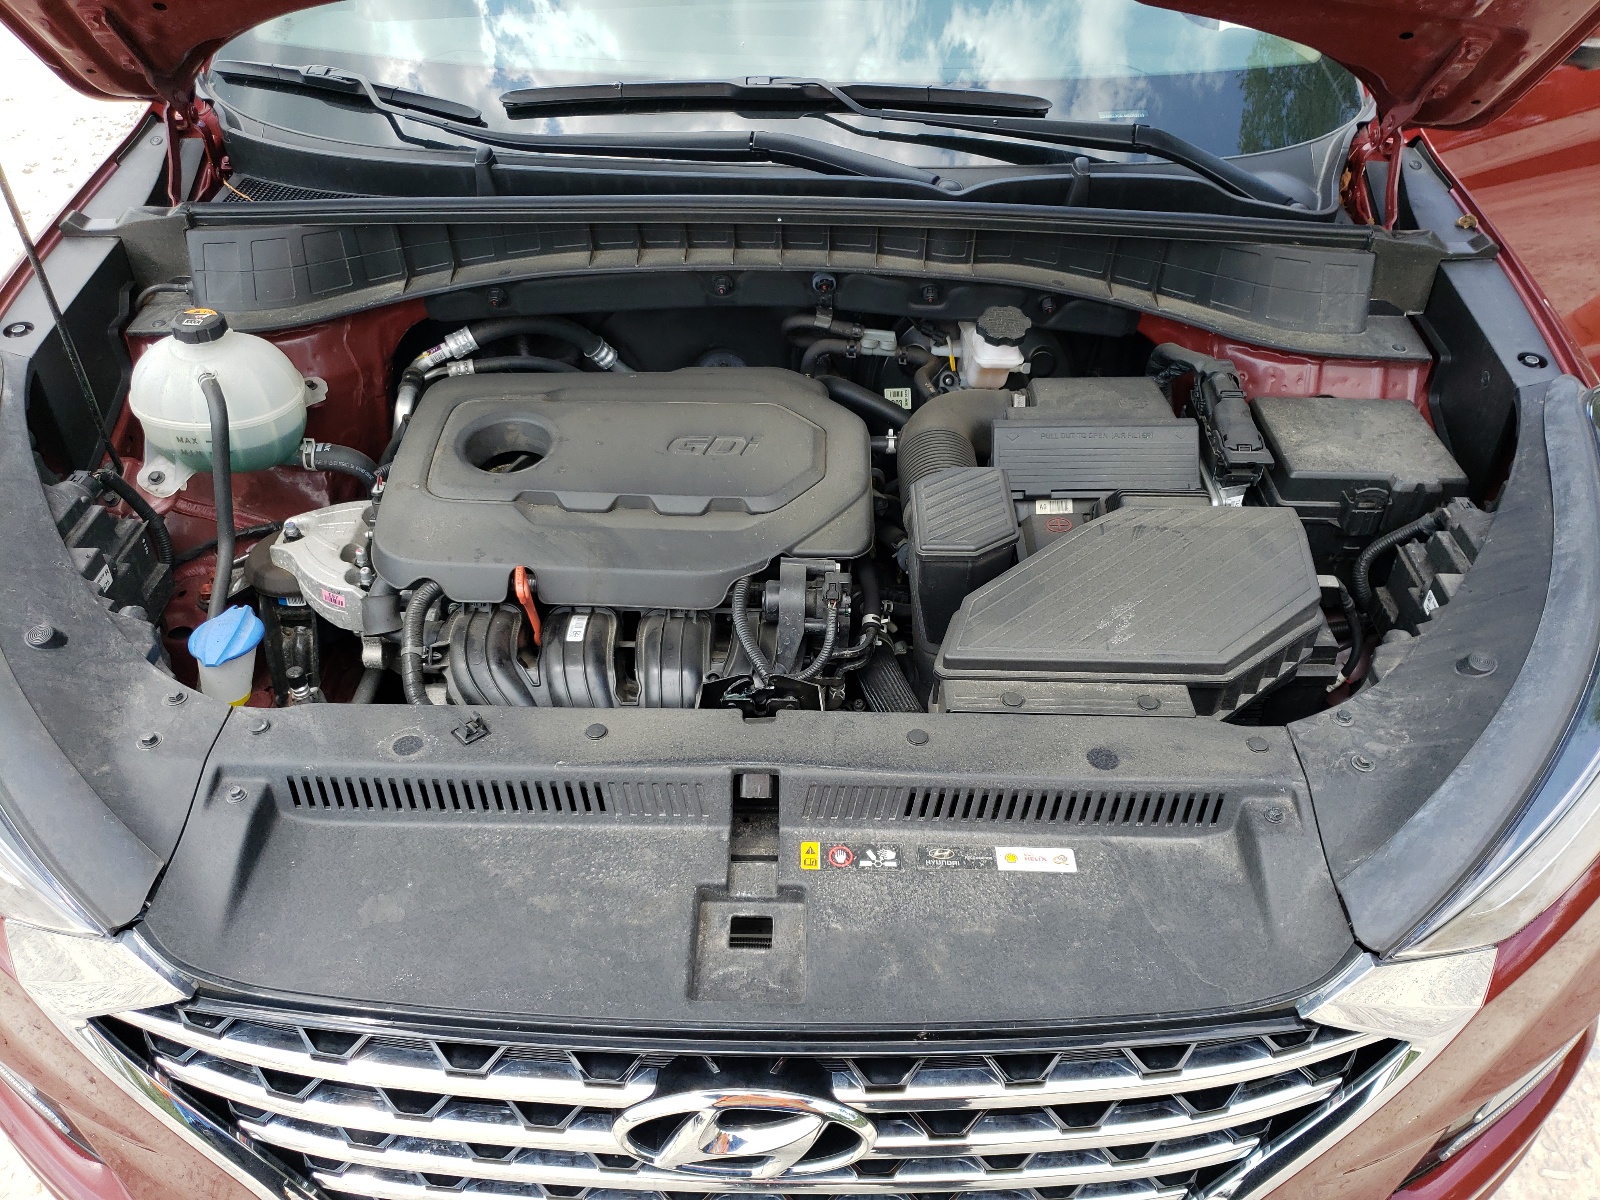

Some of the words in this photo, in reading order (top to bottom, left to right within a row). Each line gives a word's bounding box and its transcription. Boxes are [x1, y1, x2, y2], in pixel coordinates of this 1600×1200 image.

[176, 436, 198, 444] MAX
[1041, 432, 1059, 440] PULL
[1060, 432, 1076, 440] OUT
